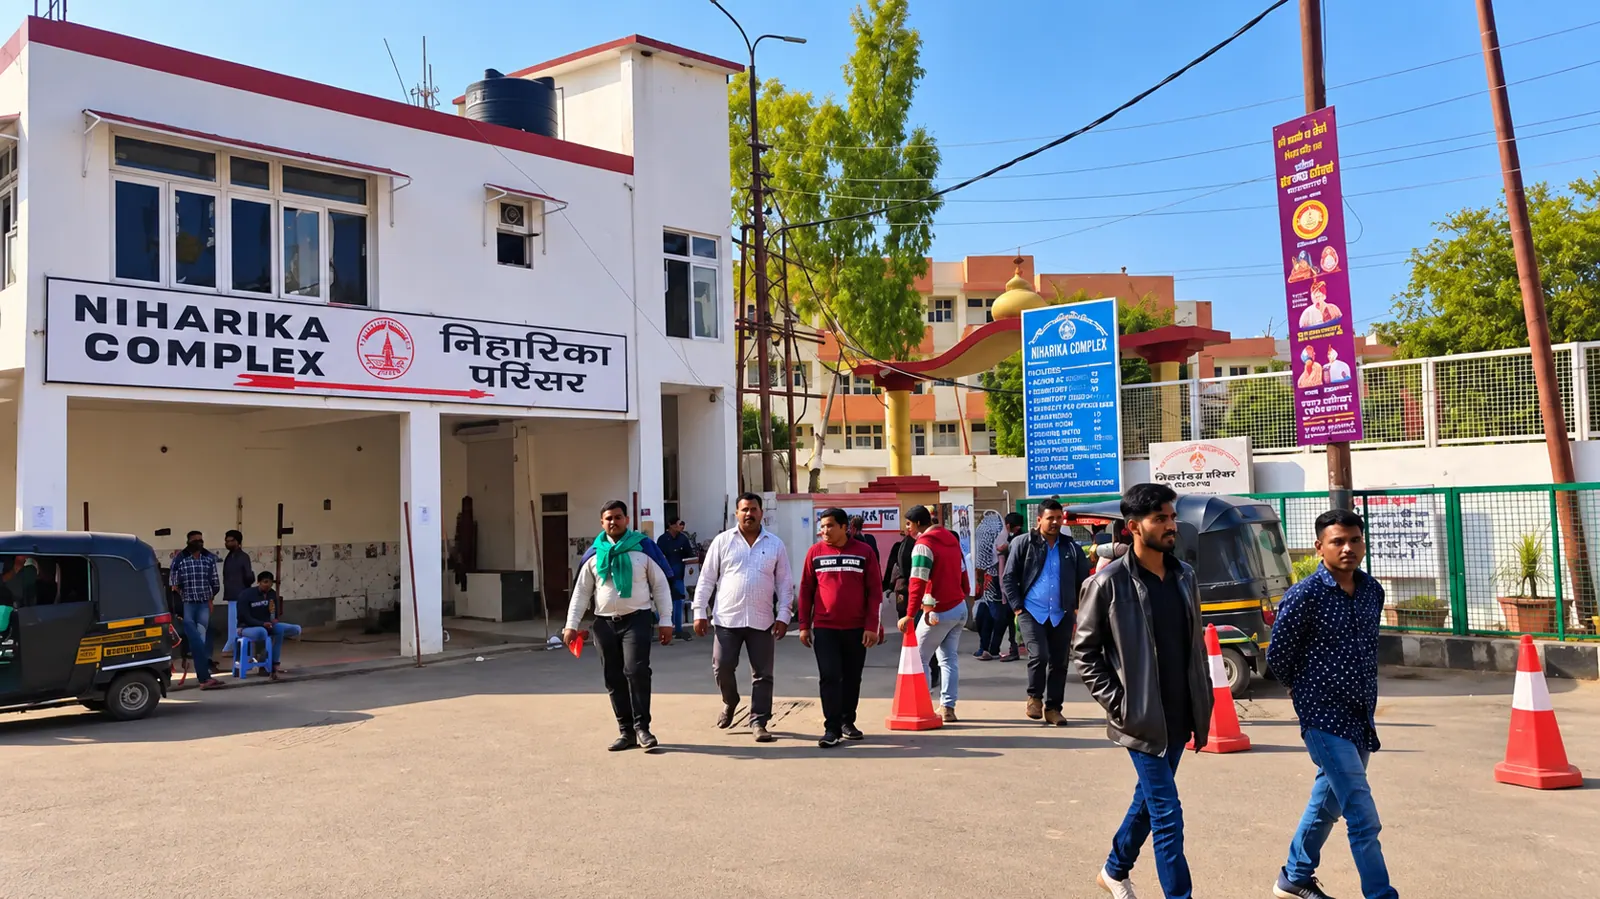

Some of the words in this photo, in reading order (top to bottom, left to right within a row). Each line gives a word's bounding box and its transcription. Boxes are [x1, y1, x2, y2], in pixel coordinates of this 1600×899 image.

[75, 294, 330, 343] NIHARIKA
[85, 332, 325, 376] COMPLEX
[439, 322, 611, 366] निहारिका
[1031, 343, 1068, 359] NIHARIKA
[1070, 338, 1107, 355] COMPLEX
